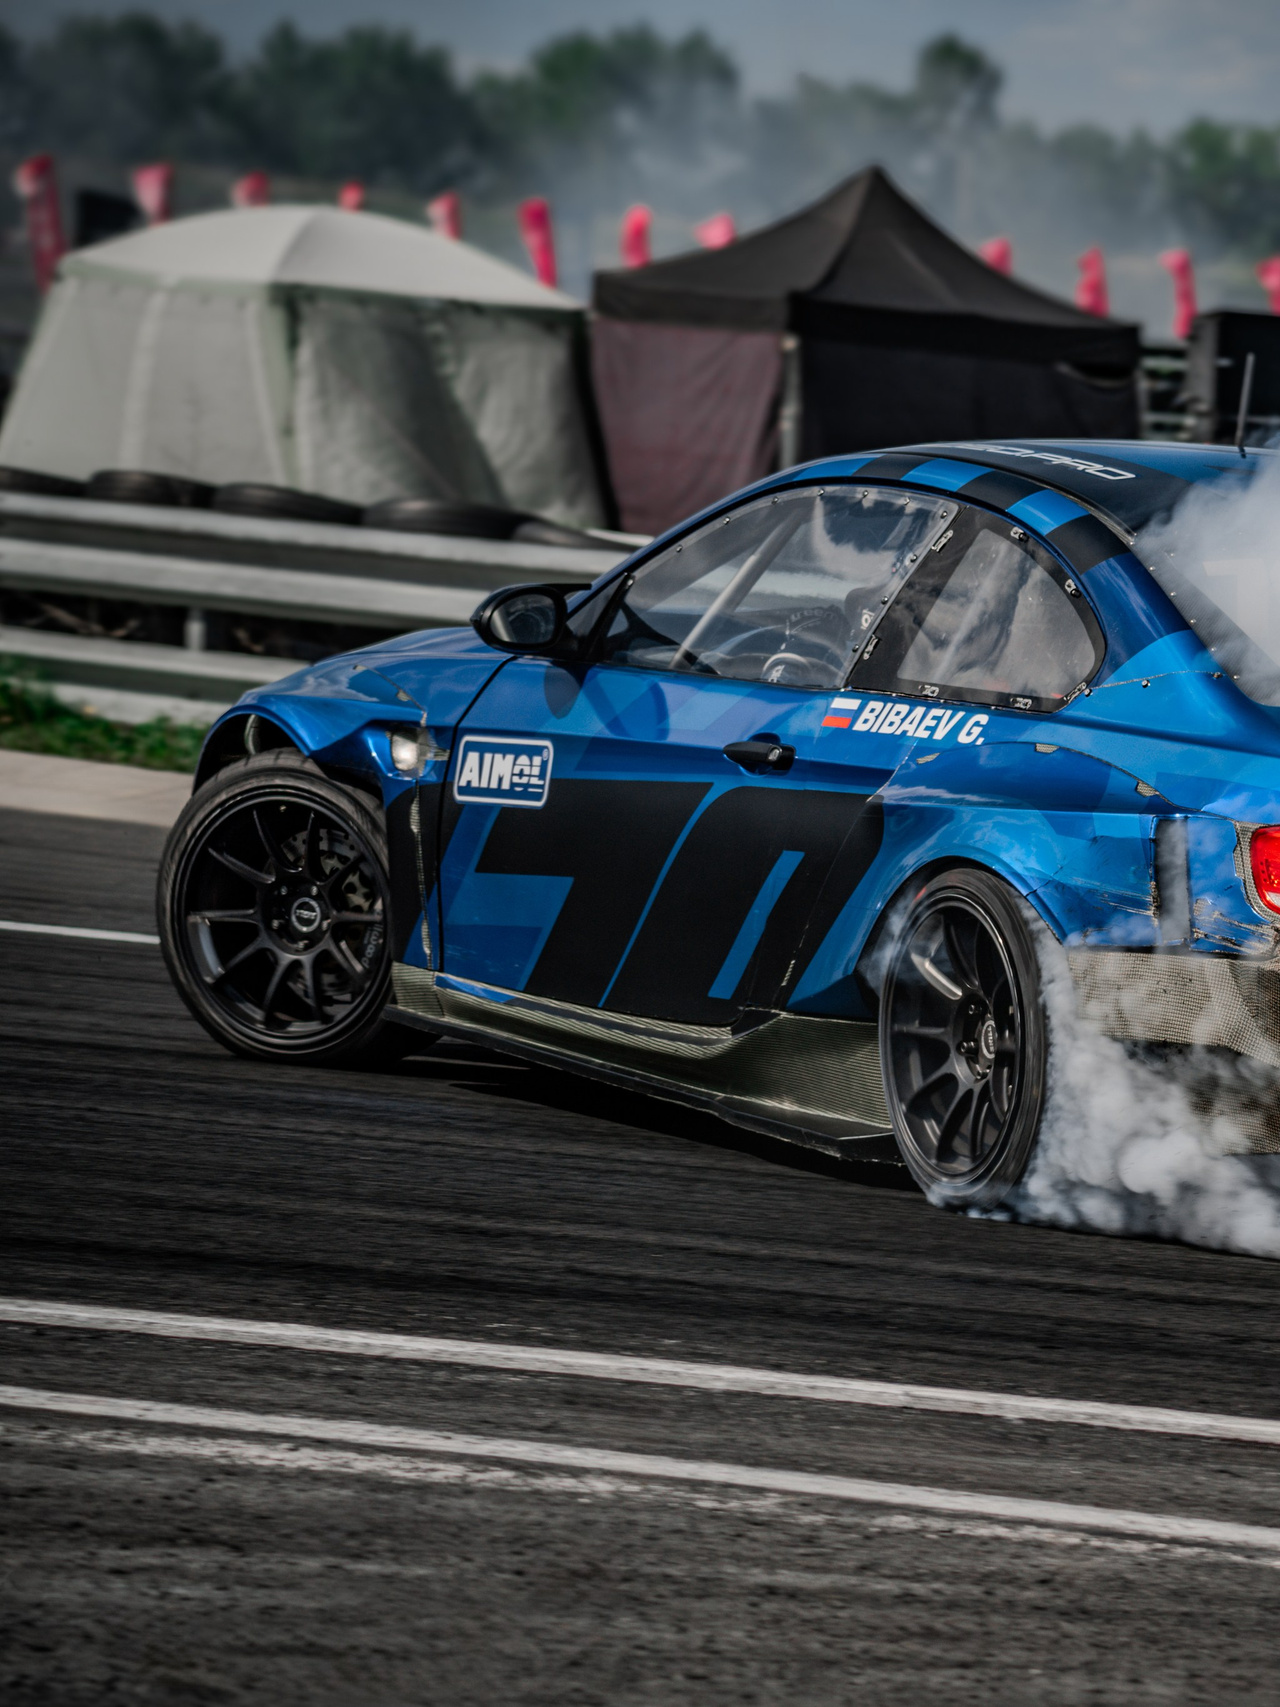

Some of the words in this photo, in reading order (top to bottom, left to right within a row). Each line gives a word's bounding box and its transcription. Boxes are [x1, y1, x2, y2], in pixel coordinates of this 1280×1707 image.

[852, 700, 966, 740] BIBAEV
[957, 713, 990, 746] G.
[458, 751, 545, 793] AIMOL
